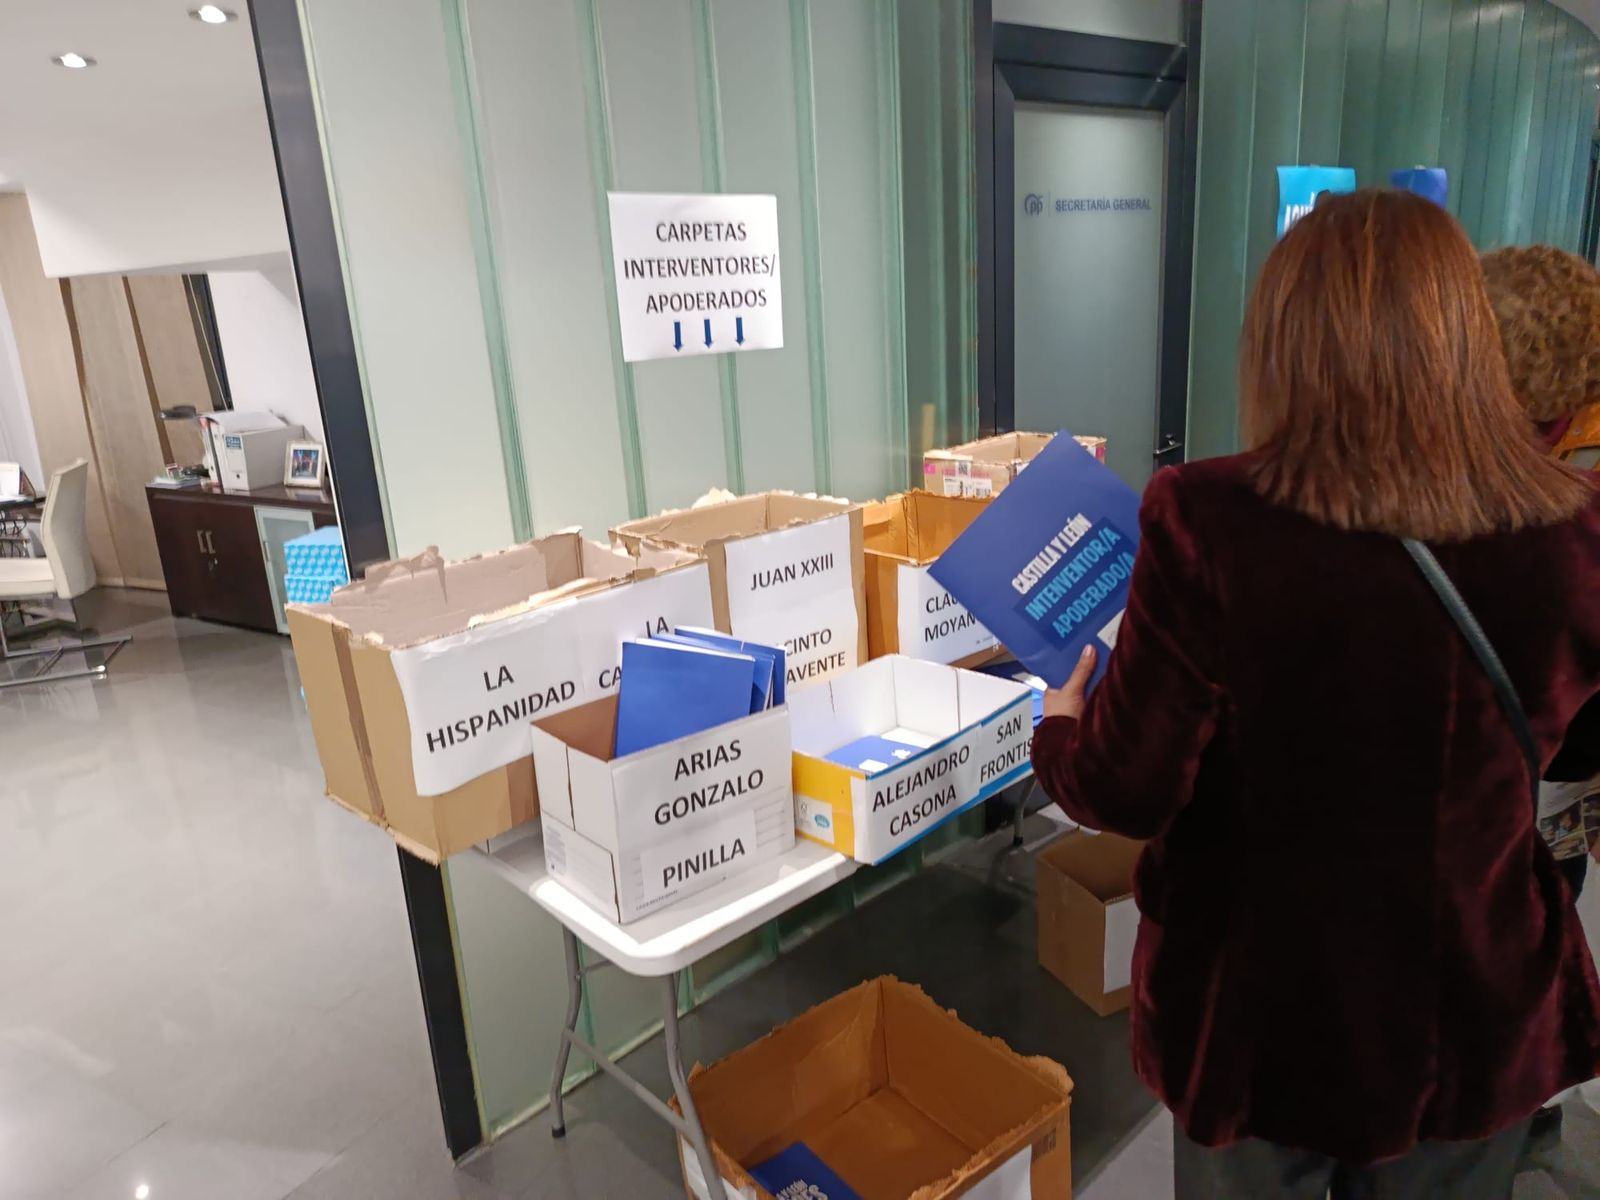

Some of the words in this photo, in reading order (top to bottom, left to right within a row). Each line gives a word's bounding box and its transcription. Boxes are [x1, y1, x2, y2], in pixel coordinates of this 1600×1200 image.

[1055, 196, 1110, 212] SECRETARÍA
[1112, 199, 1152, 211] GENERAL
[656, 222, 747, 242] CARPETAS
[623, 254, 776, 280] INTERVENTORES/
[646, 288, 767, 314] APODERADOS
[1049, 535, 1068, 554] Y
[1058, 513, 1093, 549] LEÓN
[751, 564, 796, 591] JUAN
[800, 552, 834, 578] XXIII
[1011, 548, 1063, 595] CASTILLA
[1053, 552, 1135, 639] APODERADO/A
[778, 628, 832, 657] CINTO
[925, 611, 976, 642] MOYAN
[483, 664, 514, 692] LA
[786, 651, 846, 685] AVENTE
[426, 680, 575, 753] HISPANIDAD
[996, 714, 1021, 744] SAN
[674, 740, 742, 781] ARIAS
[872, 745, 970, 812] ALEJANDRO
[980, 737, 1033, 784] FRONTIS
[654, 769, 764, 825] GONZALO
[890, 784, 957, 836] CASONA
[663, 838, 746, 888] PINILLA
